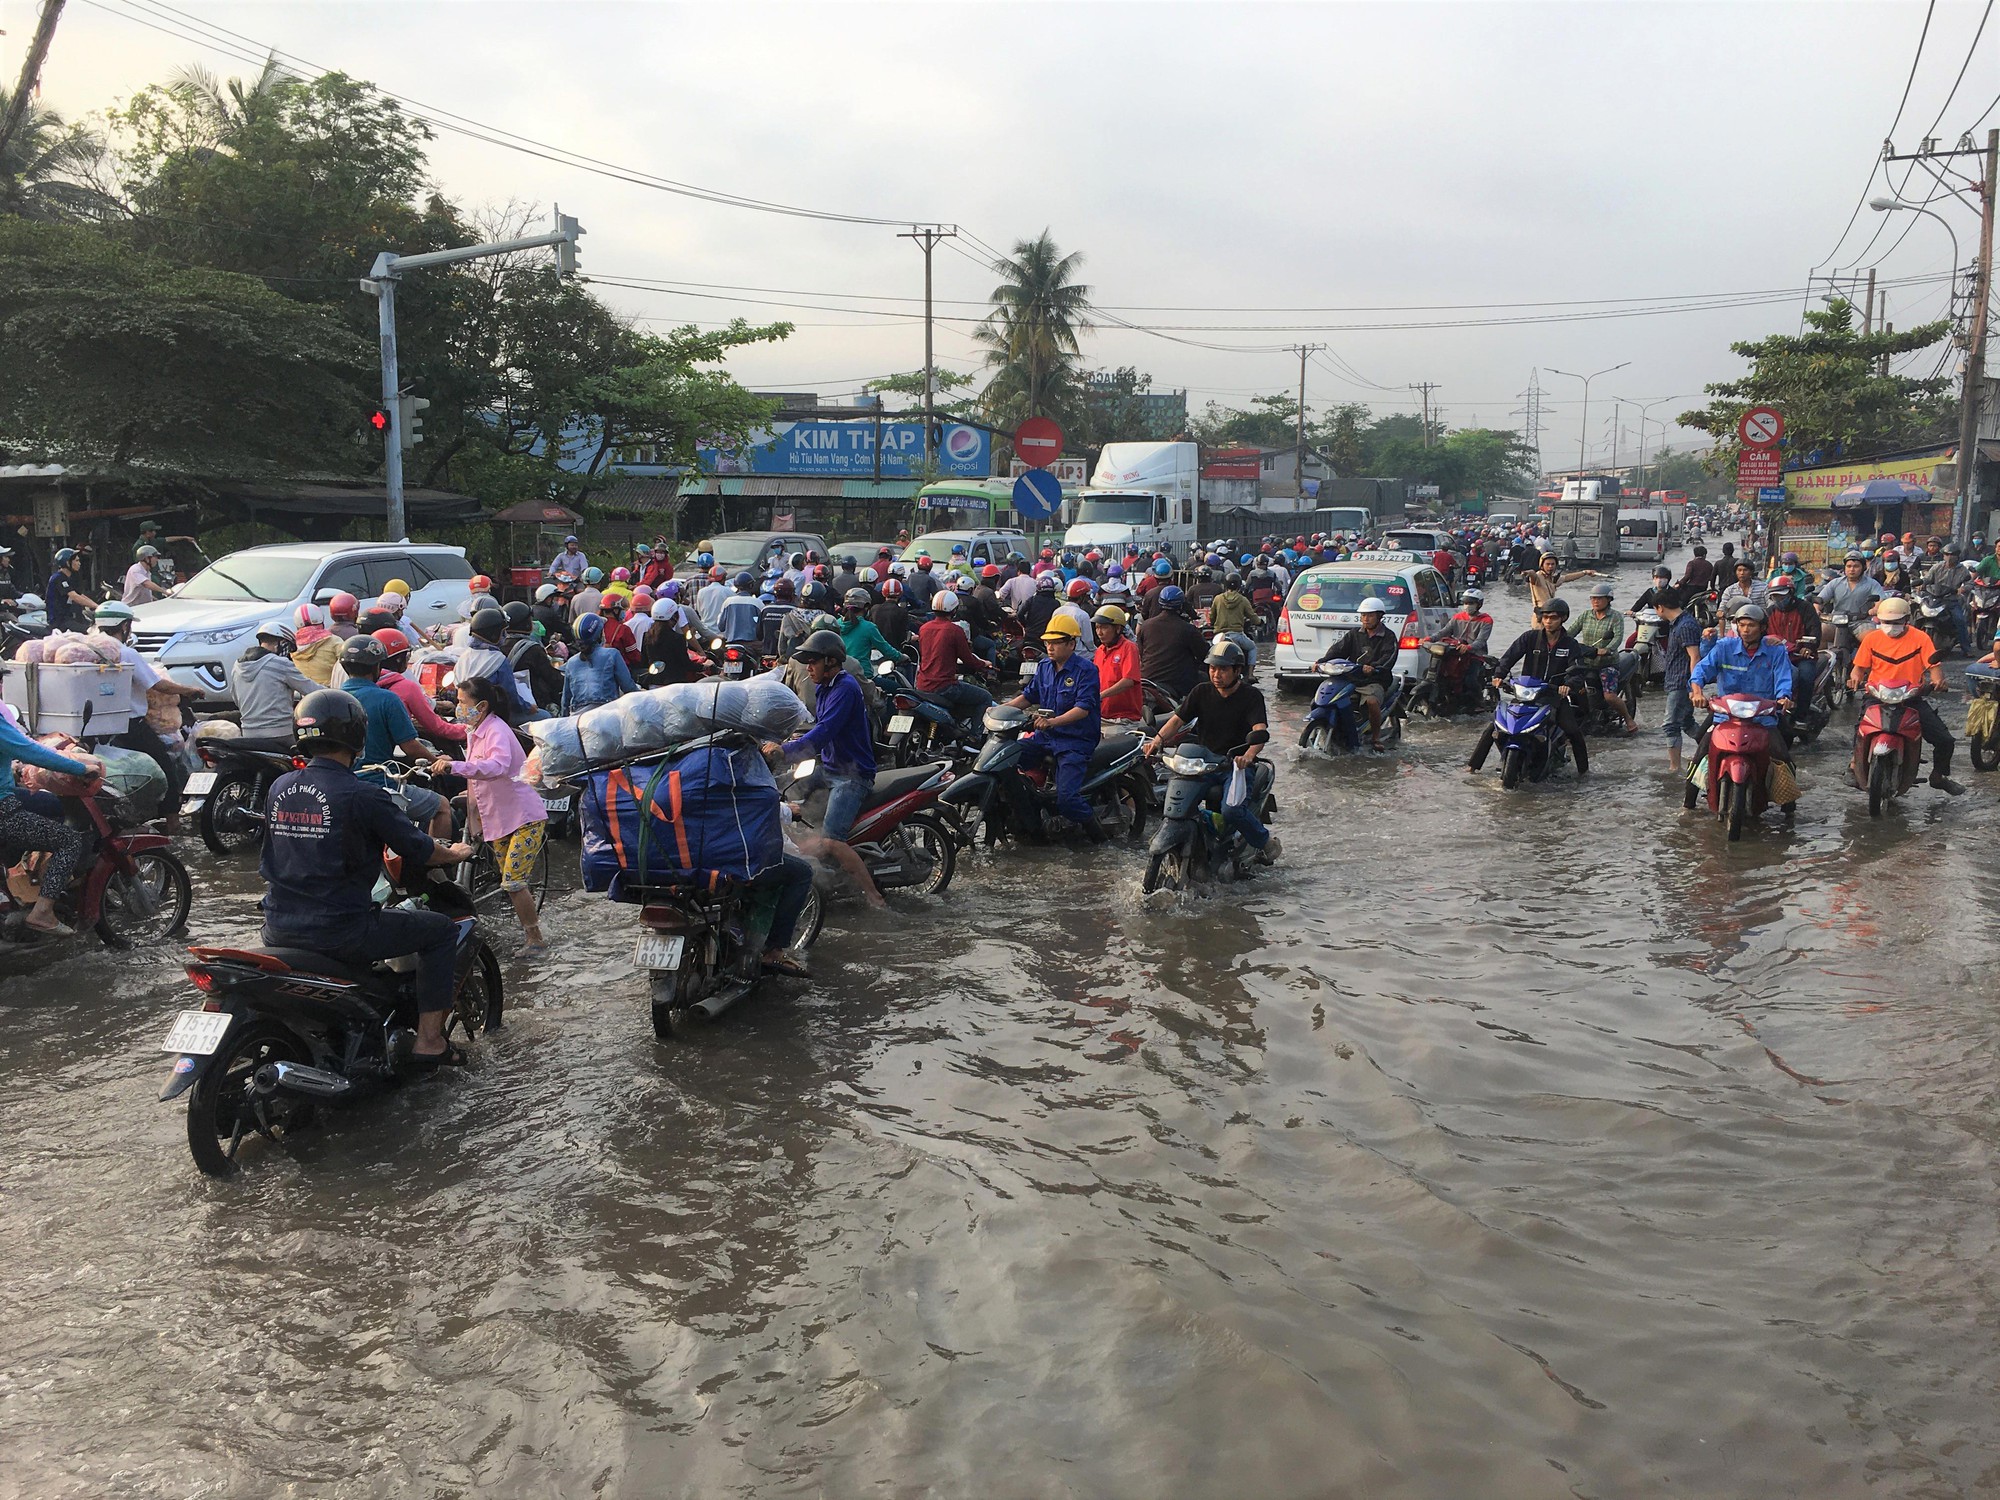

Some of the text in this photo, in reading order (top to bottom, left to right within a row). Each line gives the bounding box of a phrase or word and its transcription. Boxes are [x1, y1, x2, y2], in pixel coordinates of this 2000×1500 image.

[794, 430, 839, 449] KIM
[846, 425, 916, 450] THÁP
[789, 452, 800, 465] Hủ
[801, 453, 813, 465] Tíu
[813, 454, 829, 465] Nam
[831, 453, 849, 467] Vang
[854, 454, 871, 466] Cơm
[887, 454, 903, 466] Nam
[1749, 450, 1770, 461] CẤM
[951, 461, 978, 472] pepsi
[1076, 466, 1083, 480] 3
[1795, 472, 1836, 488] BÁNH
[920, 498, 927, 508] 9
[918, 526, 924, 534] 9
[1388, 586, 1404, 594] 7233
[1290, 613, 1322, 621] VINASUN
[1394, 616, 1405, 624] 27
[277, 791, 286, 801] TY
[182, 1014, 221, 1032] 75-F1
[167, 1034, 218, 1052] 560.19
